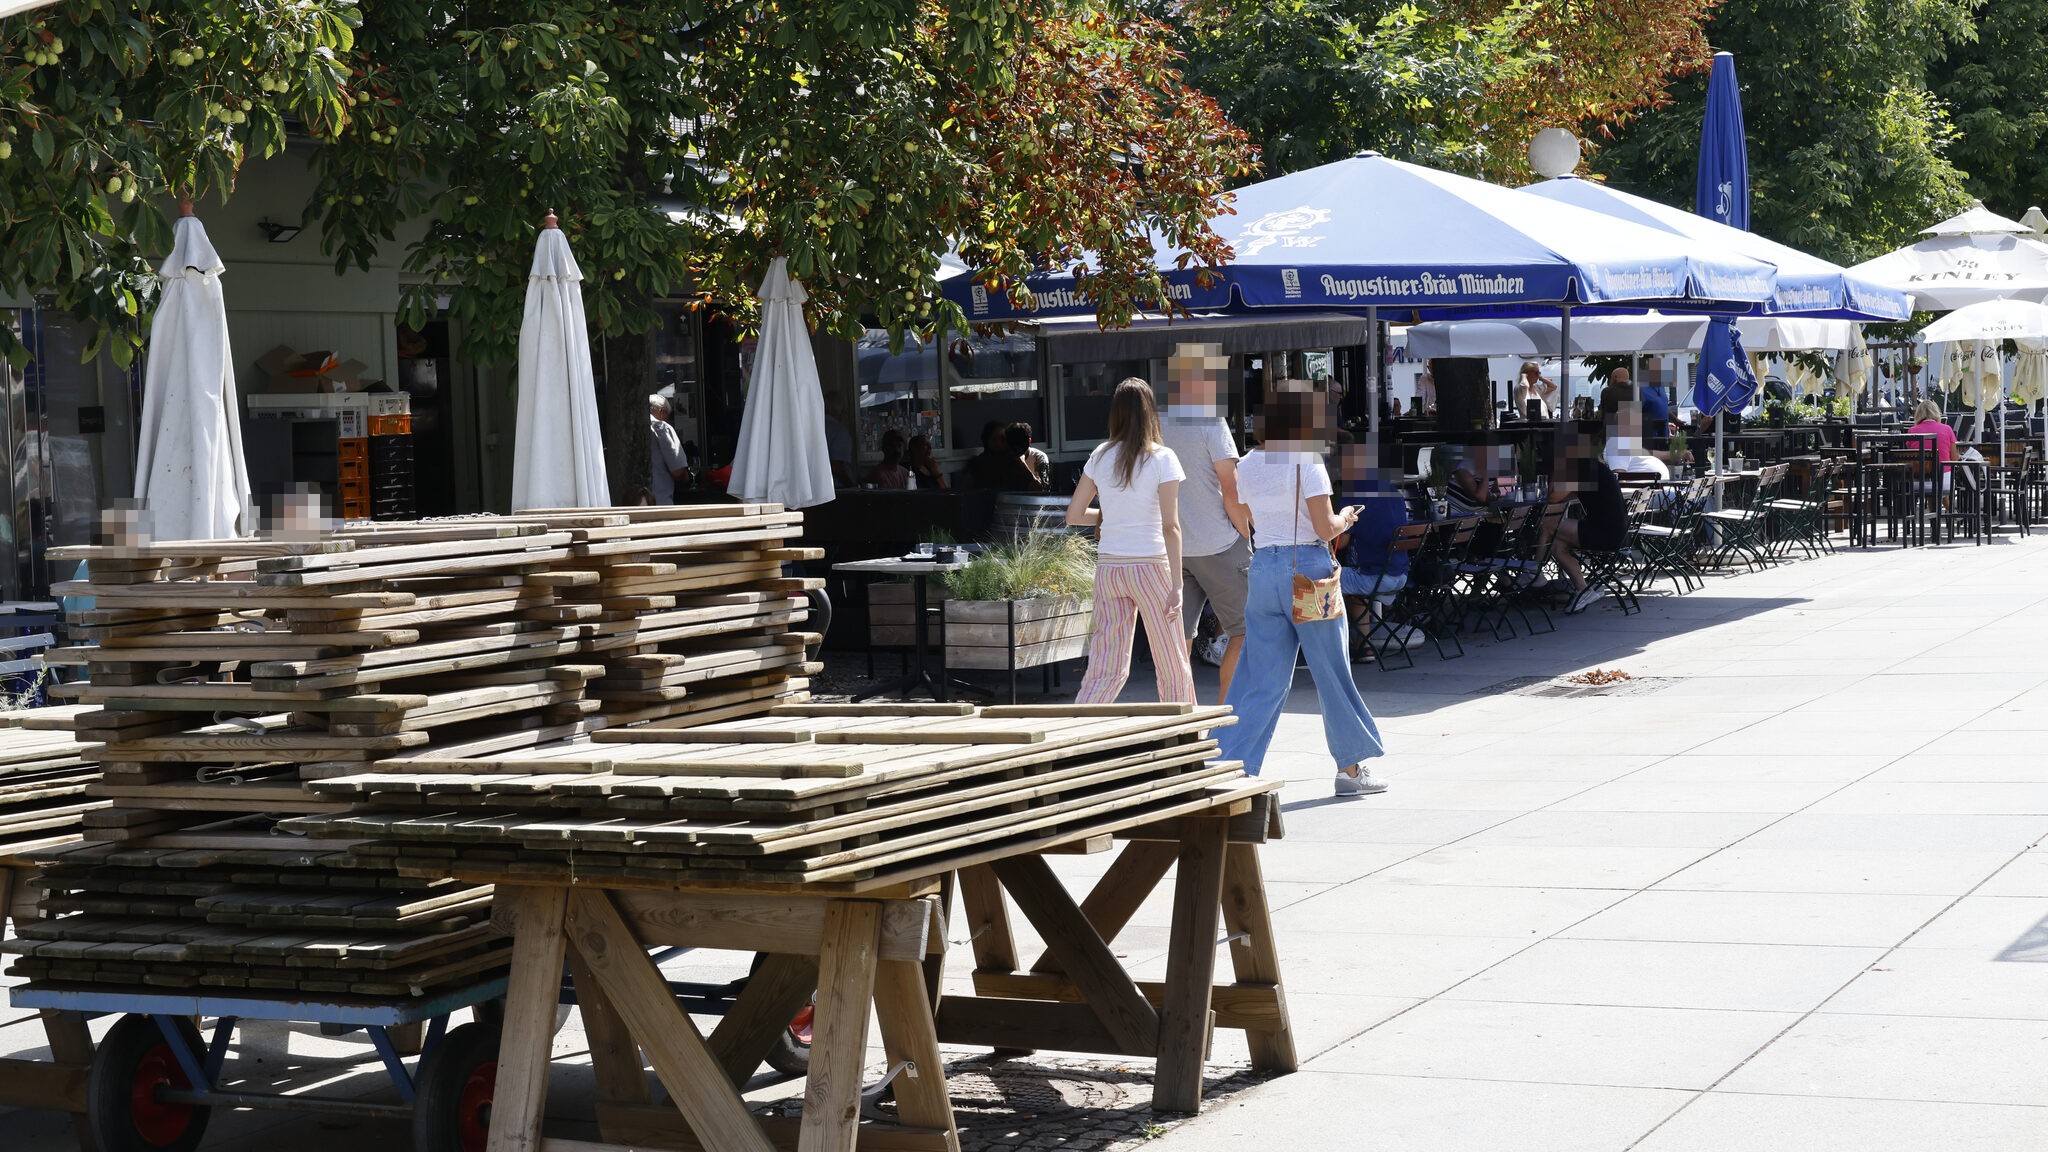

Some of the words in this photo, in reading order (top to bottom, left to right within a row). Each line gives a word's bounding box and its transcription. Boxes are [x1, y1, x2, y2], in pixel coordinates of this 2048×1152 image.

[1908, 271, 2021, 281] KINLEY
[1458, 273, 1524, 295] München
[1982, 324, 2023, 332] KINLEY
